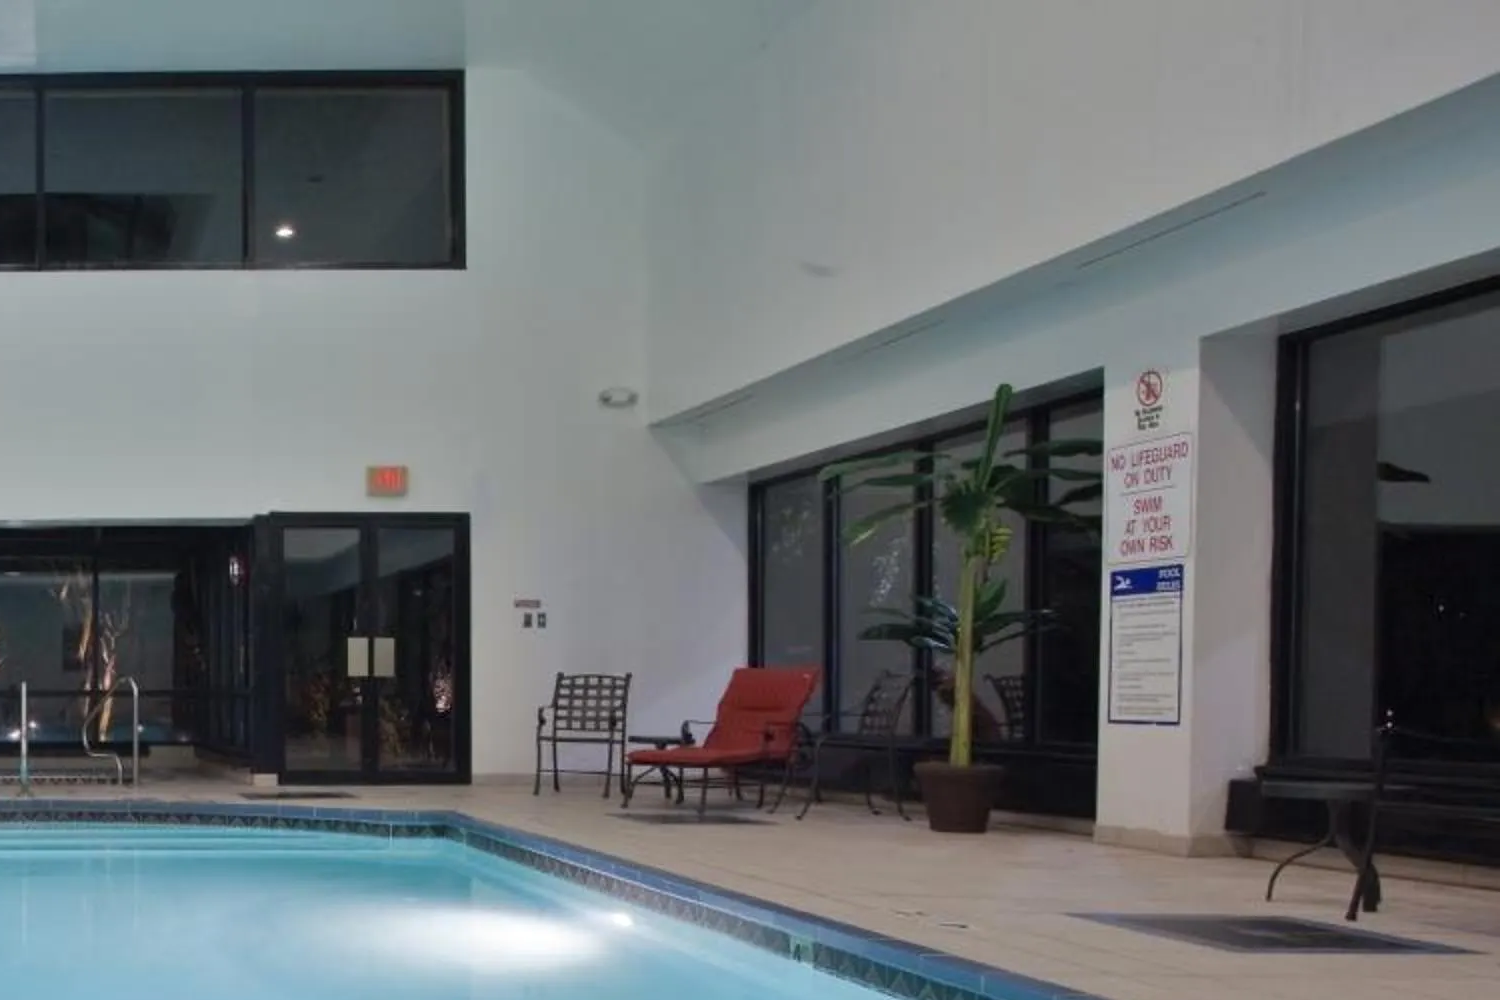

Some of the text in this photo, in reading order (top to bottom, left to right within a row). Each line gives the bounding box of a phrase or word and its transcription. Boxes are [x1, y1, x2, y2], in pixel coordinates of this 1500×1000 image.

[1111, 441, 1189, 472] NO LIFEGUARD
[1124, 466, 1172, 488] ON DUTY
[1133, 495, 1163, 514] SWIM
[1124, 515, 1172, 535] AT YOUR
[1120, 535, 1175, 556] OWN RISK
